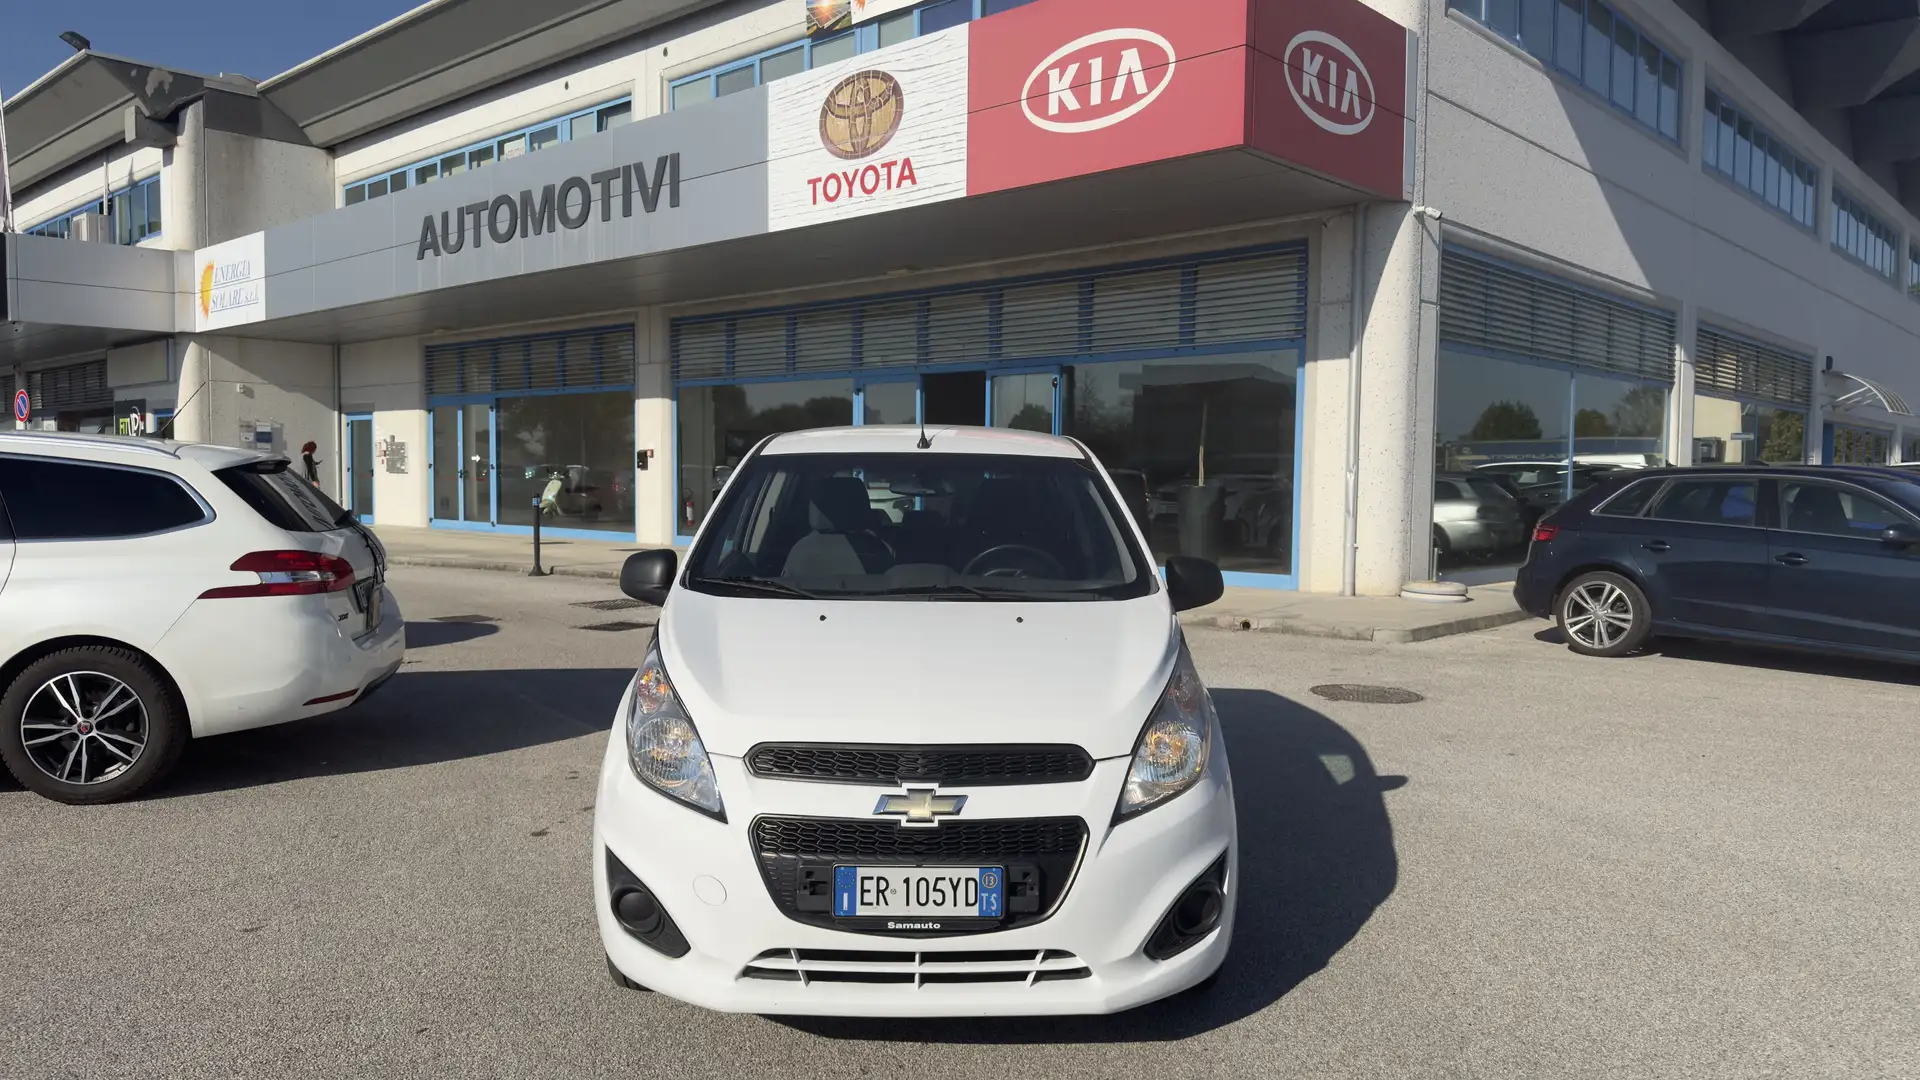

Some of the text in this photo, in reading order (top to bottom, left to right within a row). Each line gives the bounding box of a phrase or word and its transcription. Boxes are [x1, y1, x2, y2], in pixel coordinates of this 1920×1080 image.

[1047, 47, 1149, 115] KIA
[1301, 47, 1362, 119] KIA
[806, 157, 917, 206] TOYOTA
[416, 152, 680, 260] AUTOMOTIVI
[214, 260, 251, 283] ENERGIA
[211, 288, 244, 310] SOLARE
[860, 876, 979, 907] ER 105YD
[984, 875, 995, 885] 13
[981, 893, 998, 911] TS
[887, 921, 941, 929] Samauto
